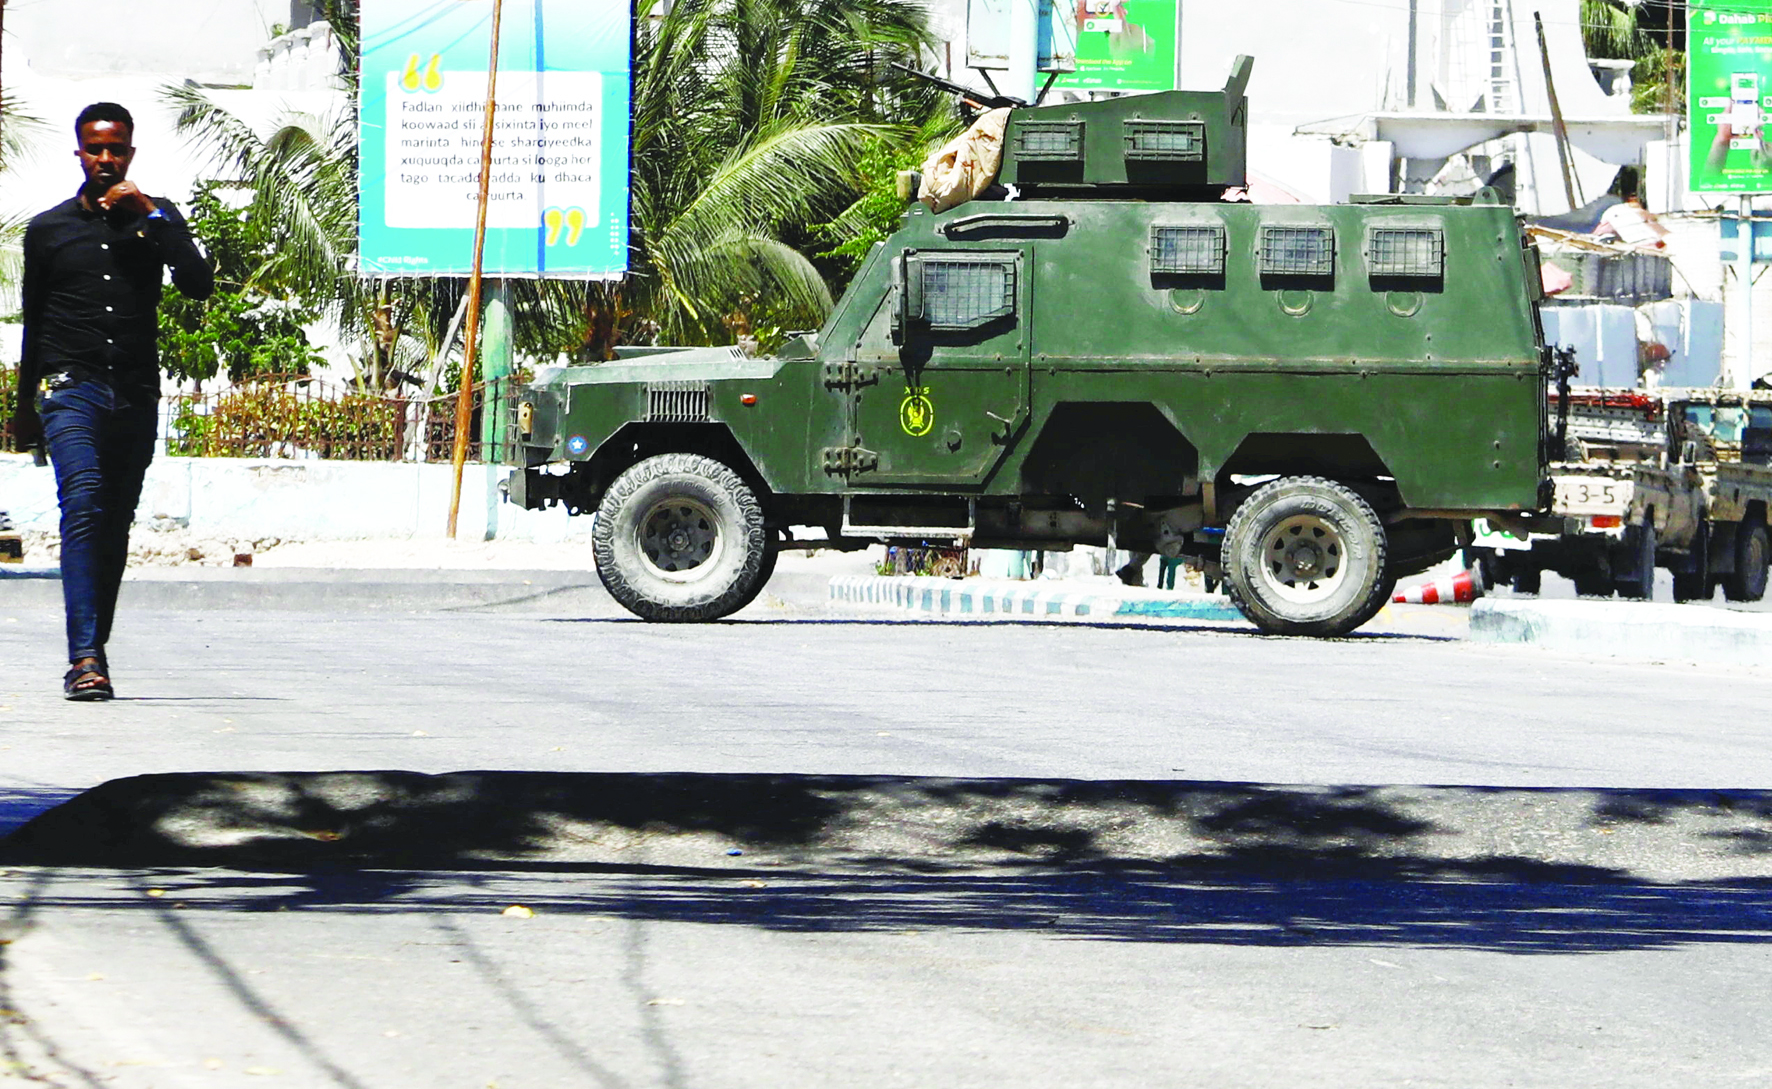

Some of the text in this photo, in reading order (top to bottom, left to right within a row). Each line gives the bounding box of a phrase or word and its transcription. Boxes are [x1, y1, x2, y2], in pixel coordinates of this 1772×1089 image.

[1719, 14, 1756, 24] Dahab
[402, 101, 442, 112] Fadlan
[531, 100, 593, 112] muhiimda
[401, 119, 458, 130] koowaad
[463, 118, 476, 130] sii
[539, 118, 558, 132] iyo
[562, 118, 593, 130] meel
[401, 136, 450, 147] marinta
[511, 136, 592, 148] sharciyeedka
[401, 154, 463, 167] xuquuqda
[522, 154, 532, 166] si
[534, 154, 568, 167] looga
[571, 154, 592, 166] hor
[401, 173, 429, 185] tago
[530, 172, 545, 184] ku
[555, 172, 592, 183] dhaca
[1578, 484, 1615, 504] 3-5
